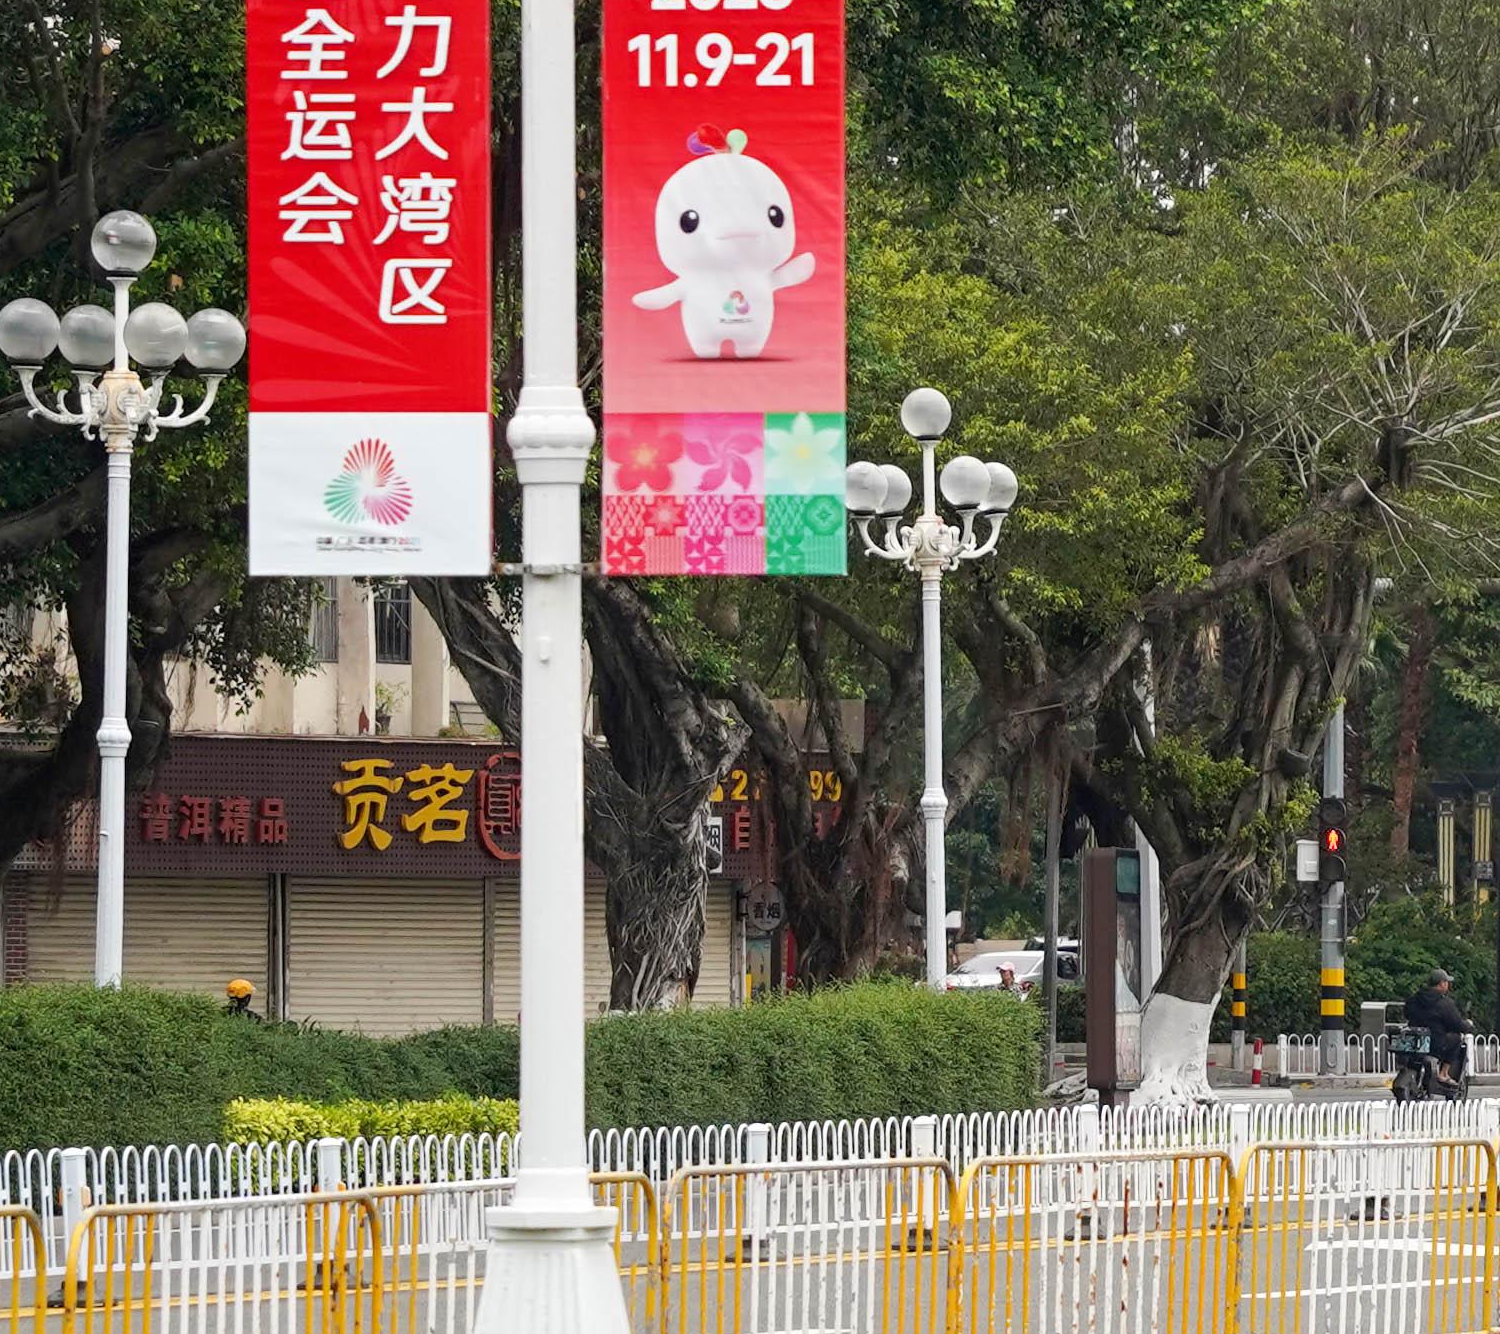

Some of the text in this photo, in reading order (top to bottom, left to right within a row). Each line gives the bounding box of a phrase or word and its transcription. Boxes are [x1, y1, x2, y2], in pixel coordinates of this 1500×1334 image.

[628, 33, 815, 87] 11.9-21
[139, 793, 290, 844] 普洱精品
[332, 759, 475, 851] 贡茗
